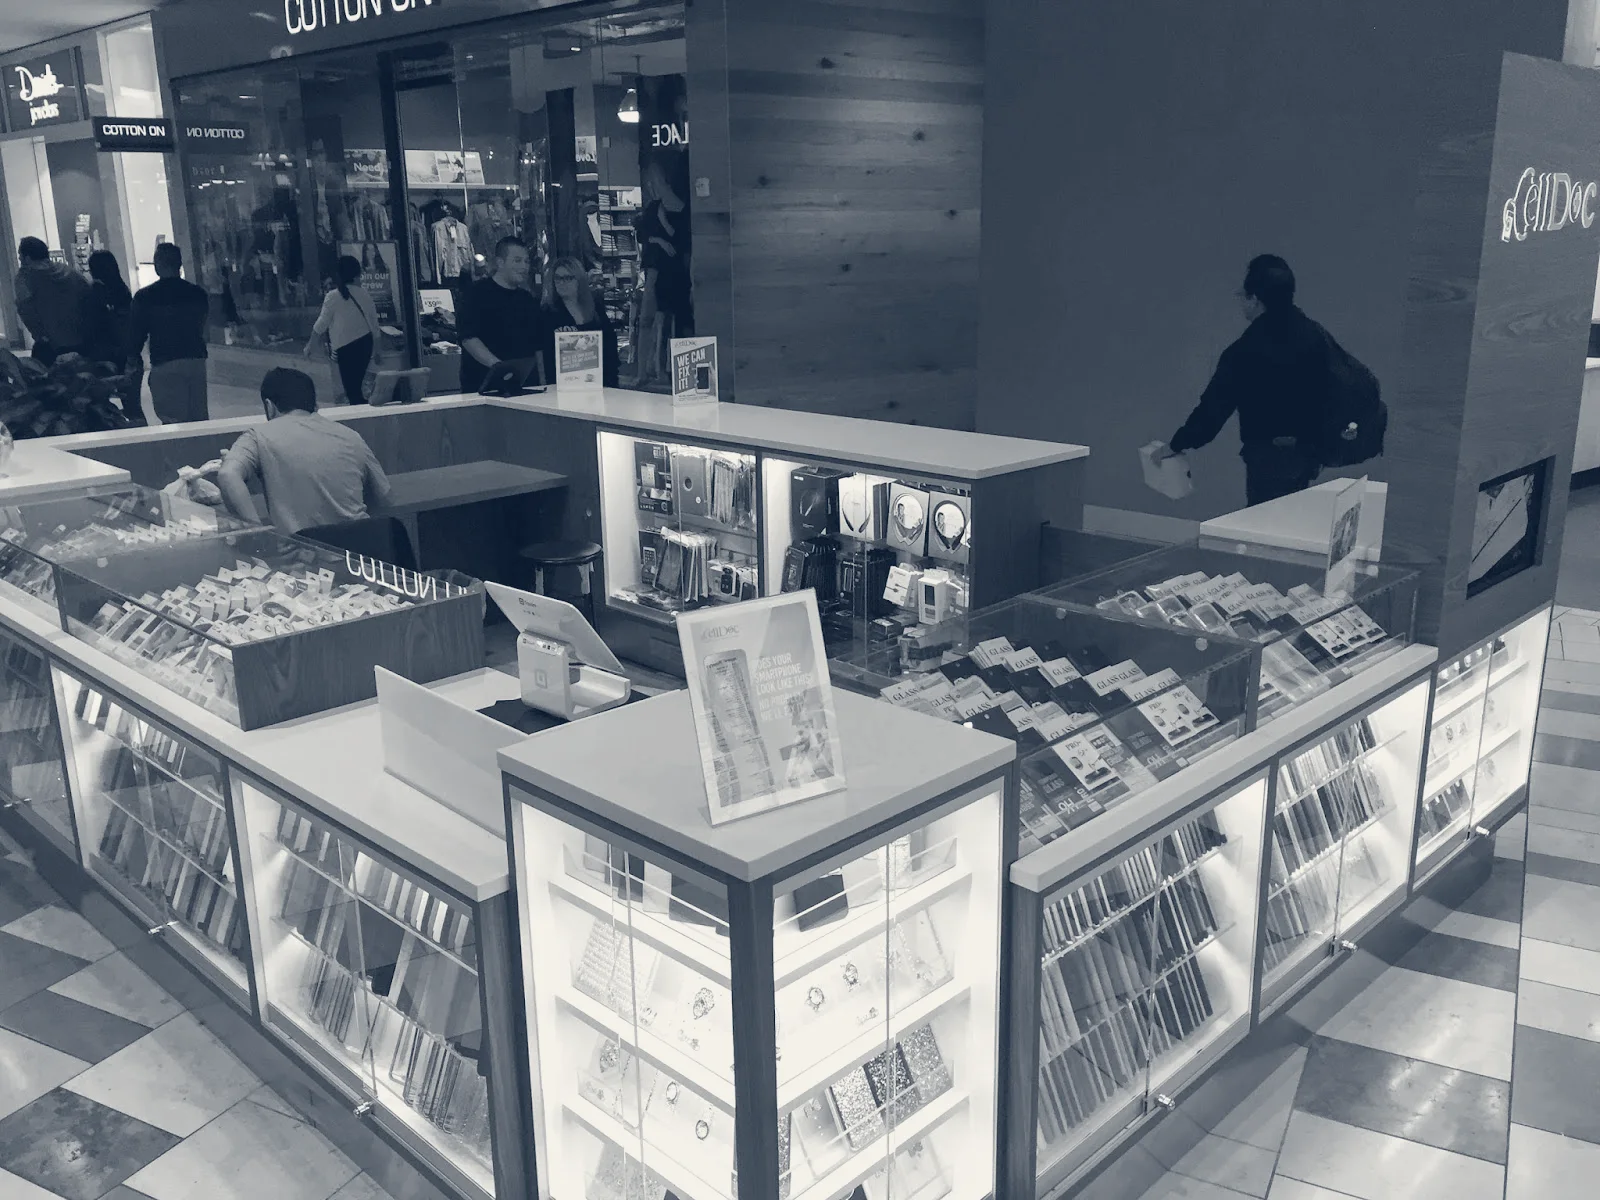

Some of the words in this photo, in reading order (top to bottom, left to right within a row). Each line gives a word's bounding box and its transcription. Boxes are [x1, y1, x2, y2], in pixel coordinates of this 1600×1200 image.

[102, 124, 147, 137] COTTON
[148, 125, 166, 137] ON
[361, 282, 384, 290] crew
[676, 353, 690, 368] WE
[690, 347, 706, 363] CAN
[678, 364, 690, 379] FIX
[678, 377, 689, 390] IT!
[988, 645, 1013, 656] GLASS
[1015, 655, 1039, 668] GLASS
[1052, 664, 1075, 676] GLASS
[1118, 667, 1141, 681] GLASS
[1096, 674, 1120, 690] GLASS
[892, 686, 920, 702] GLASS
[930, 693, 954, 708] GLAS
[965, 701, 992, 716] GLASS
